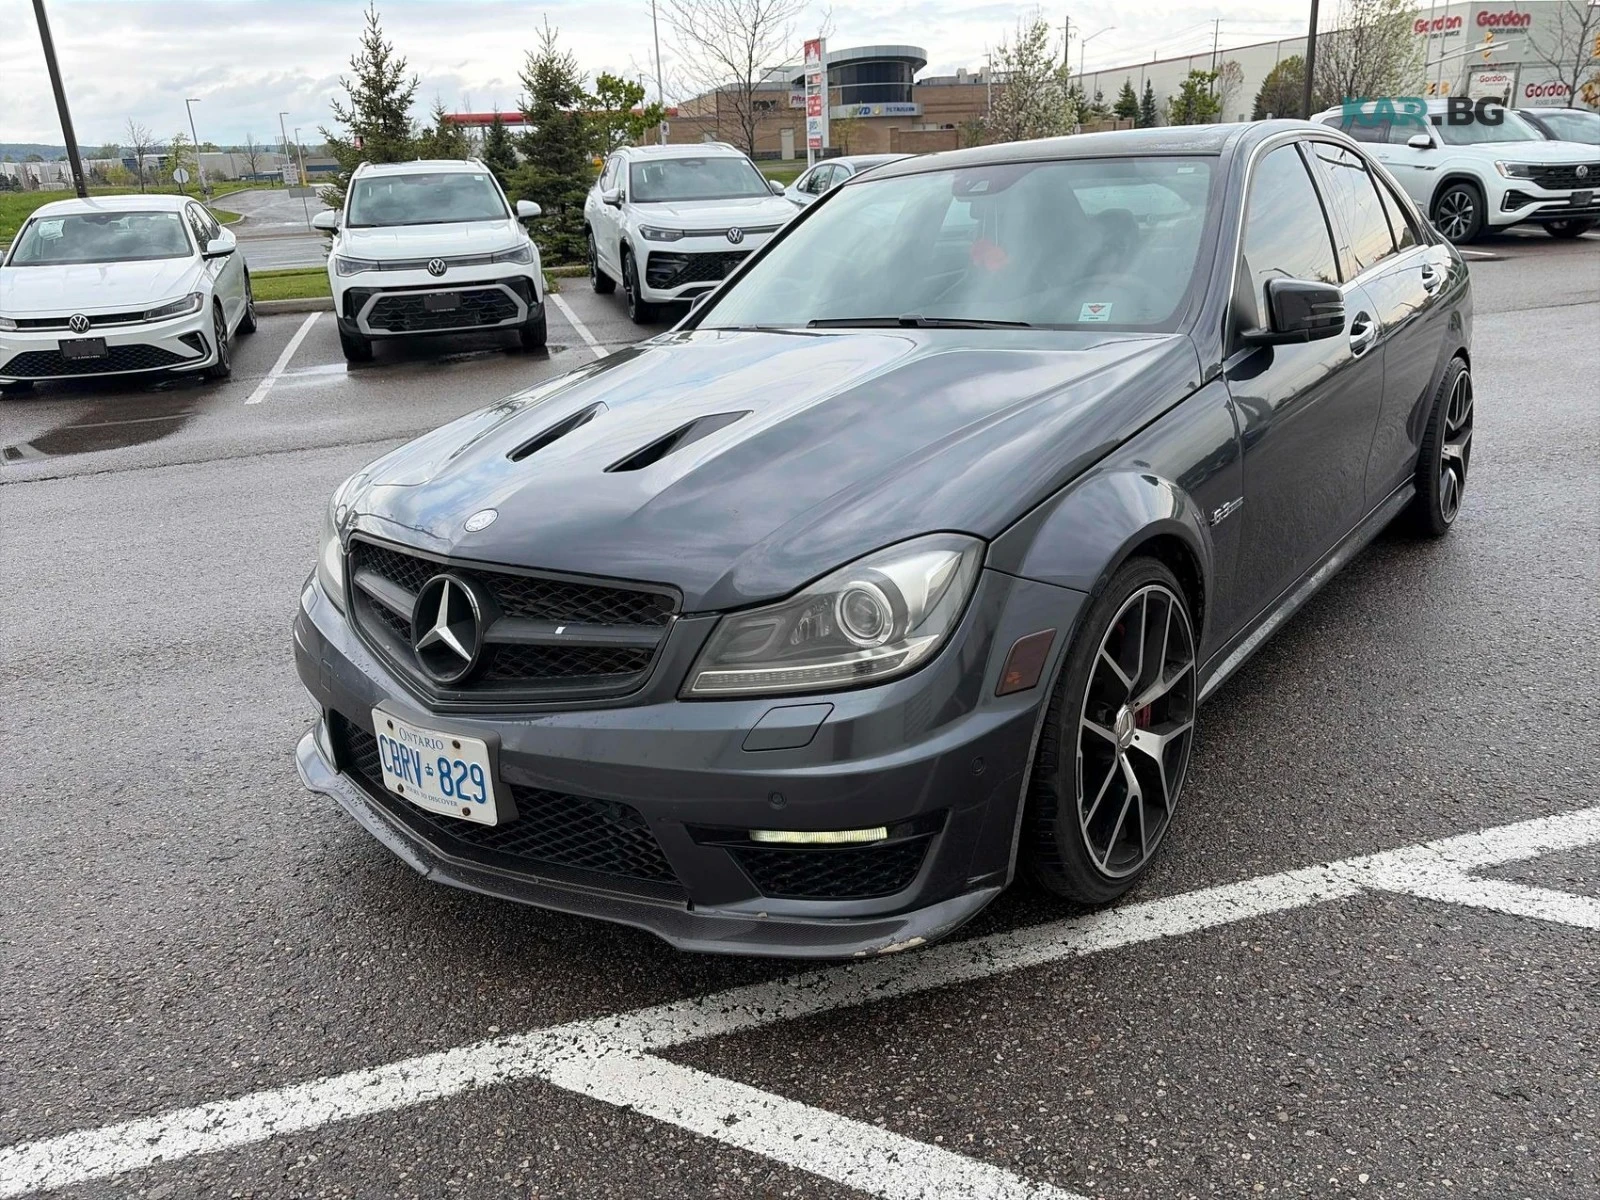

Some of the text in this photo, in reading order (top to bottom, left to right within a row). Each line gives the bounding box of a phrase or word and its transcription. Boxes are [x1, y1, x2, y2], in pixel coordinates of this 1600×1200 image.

[1414, 15, 1463, 33] Gordon
[1477, 10, 1531, 27] Gordon
[1480, 74, 1508, 83] Gordon
[1525, 82, 1572, 98] Gordon
[399, 727, 444, 750] ONTARIO
[379, 734, 487, 804] CBRV 829
[428, 795, 458, 807] DISCOVER
